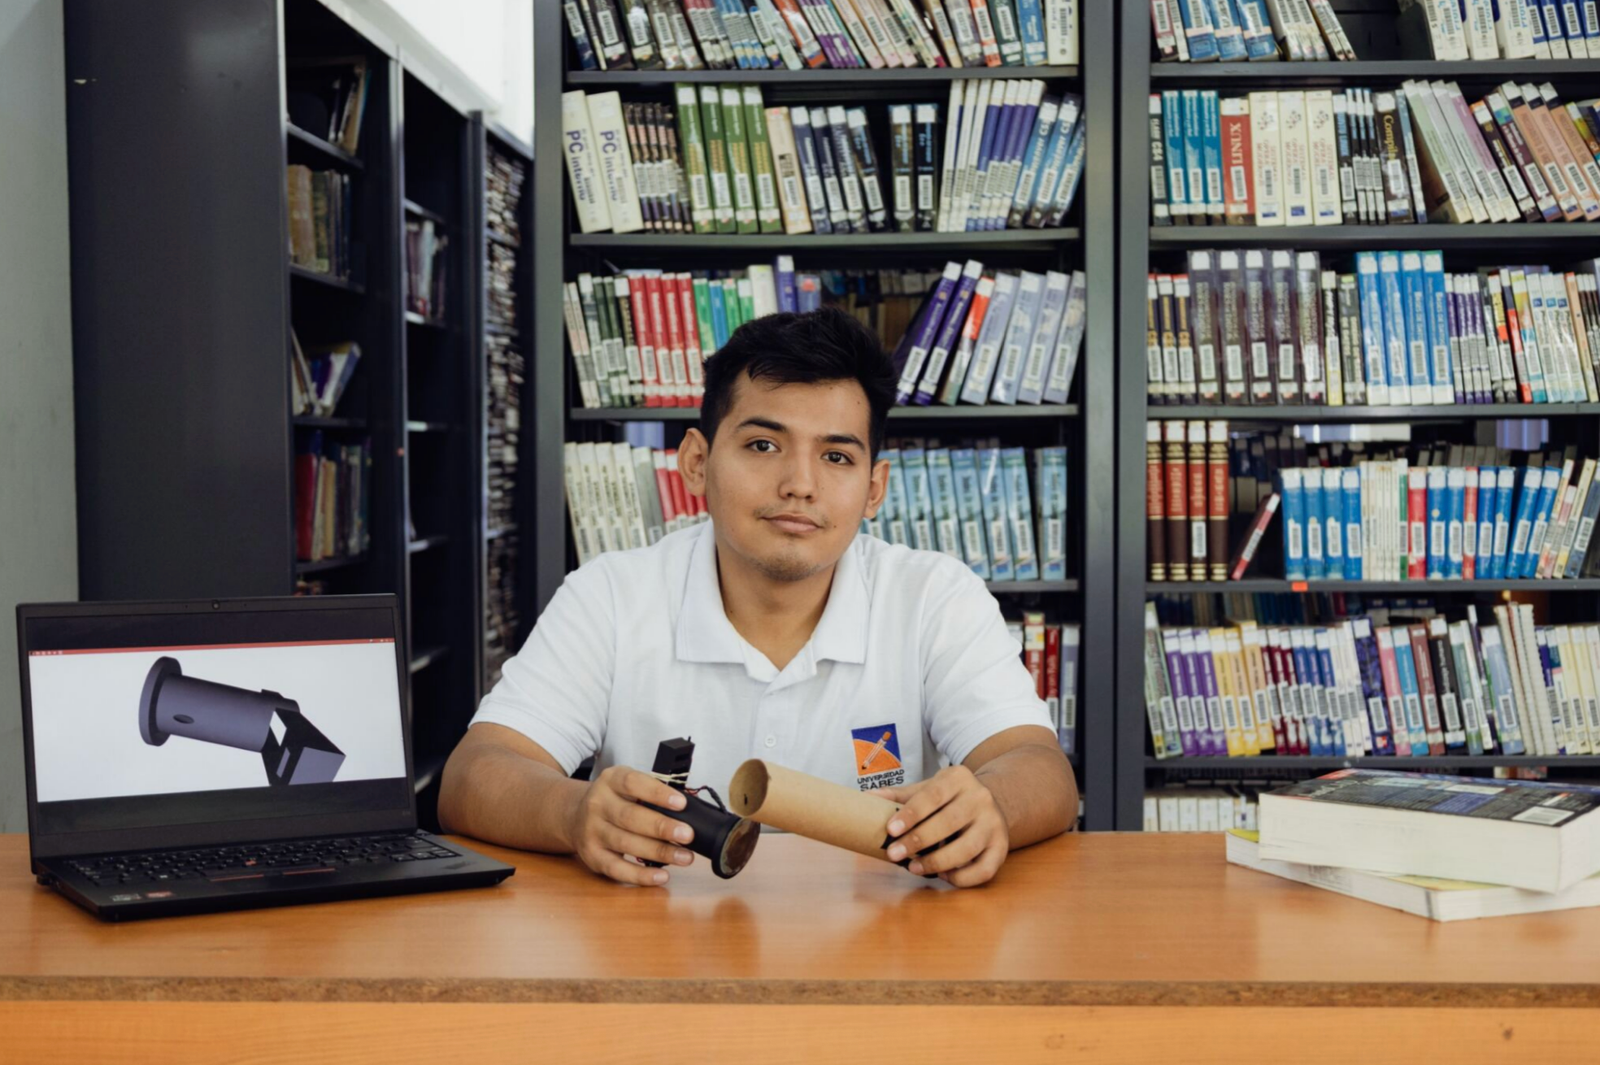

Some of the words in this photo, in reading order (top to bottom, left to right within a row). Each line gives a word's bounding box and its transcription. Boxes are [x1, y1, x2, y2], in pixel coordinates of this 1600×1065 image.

[566, 130, 584, 154] PC
[600, 130, 617, 154] PC
[1229, 123, 1243, 164] LINUX
[857, 769, 904, 784] UNIVERSIDAD
[860, 776, 904, 791] SABES
